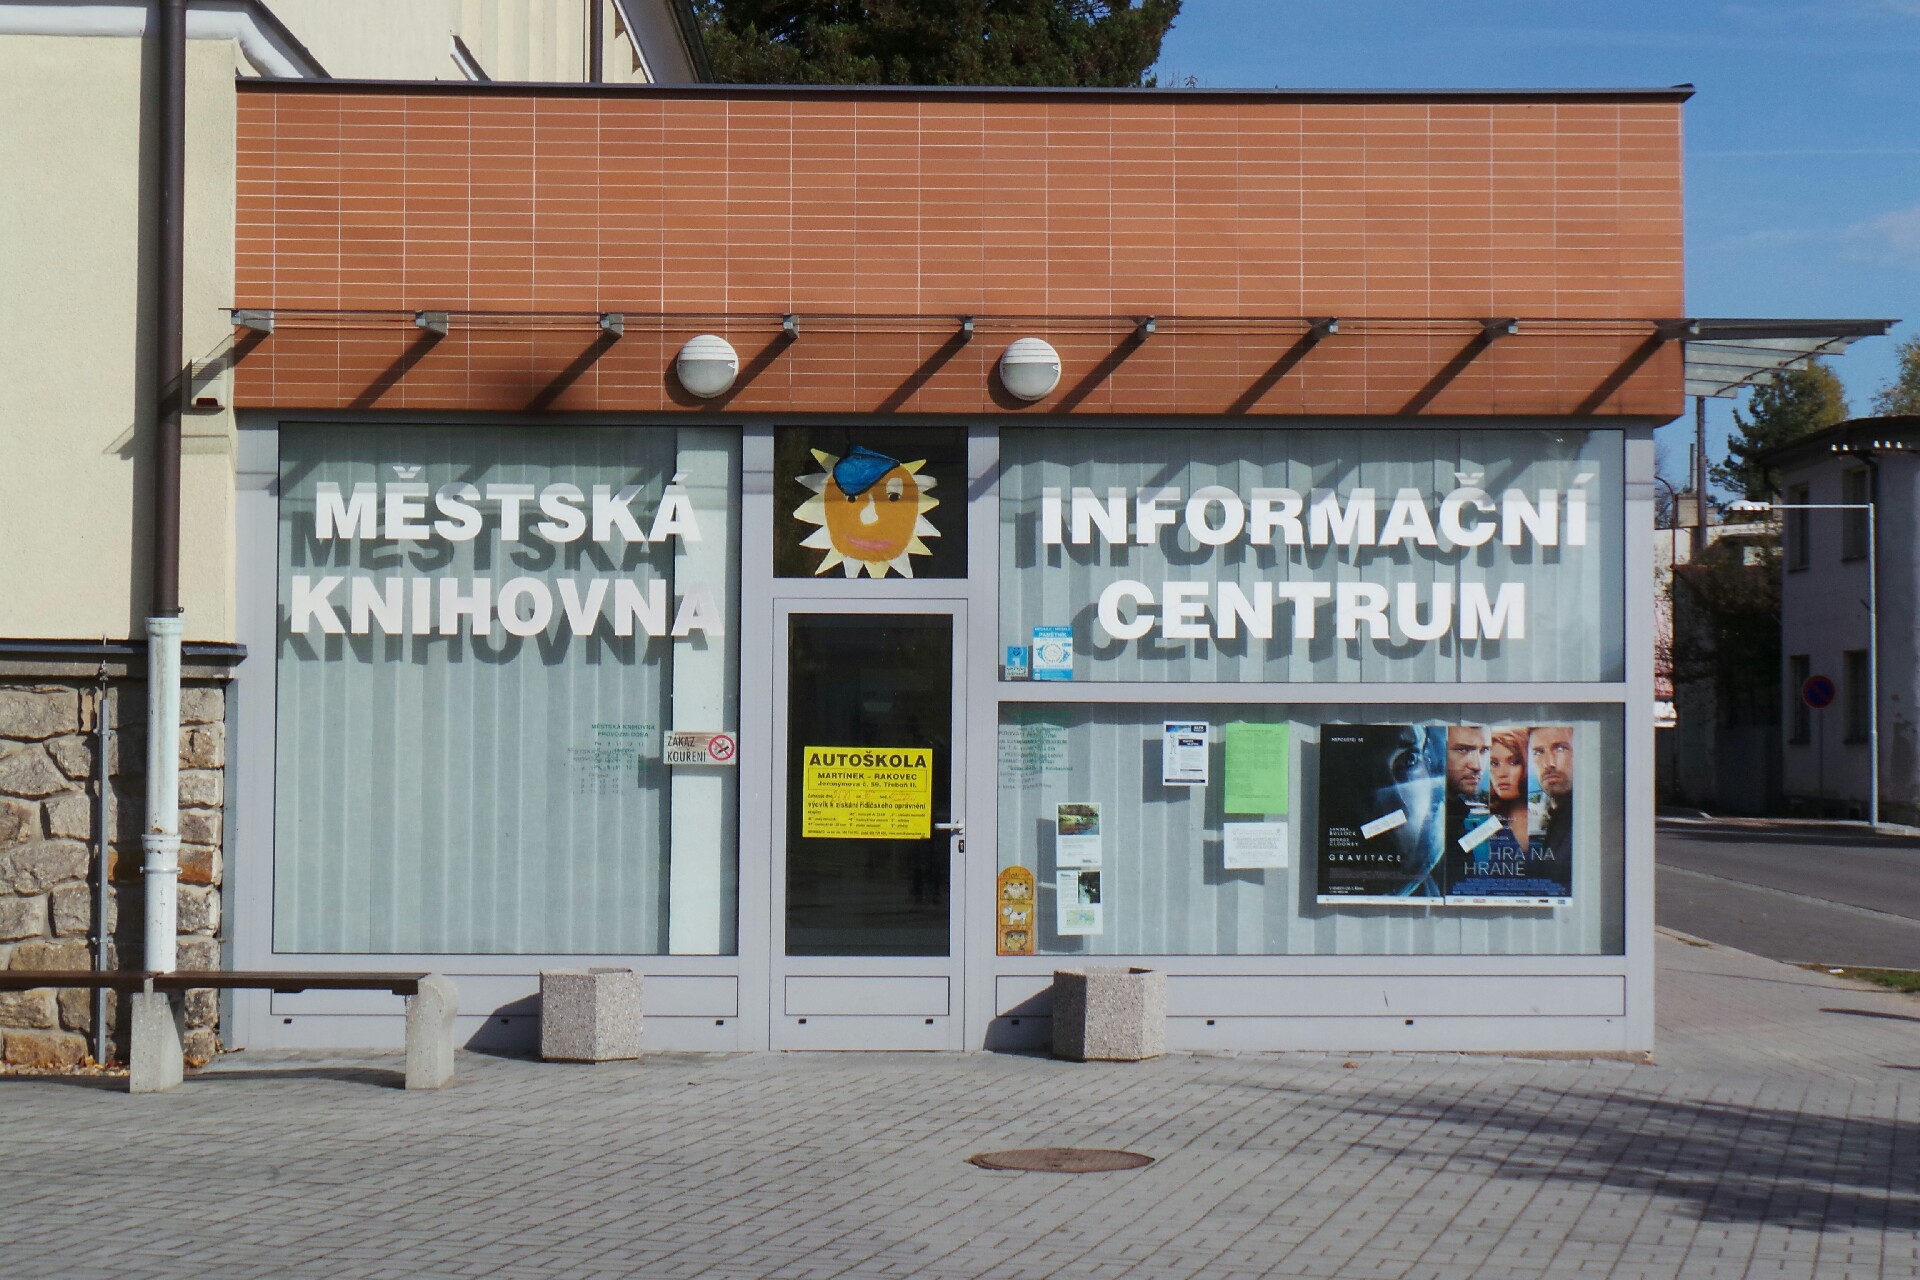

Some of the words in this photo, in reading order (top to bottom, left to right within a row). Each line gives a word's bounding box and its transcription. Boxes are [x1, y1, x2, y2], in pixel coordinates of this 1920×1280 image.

[315, 466, 703, 543] MĚSTSKÁ
[1042, 473, 1595, 547] INFORMAČNÍ
[290, 576, 725, 637] KNIHOVNA
[1097, 579, 1525, 640] CENTRUM
[667, 735, 696, 747] ZÁKAZ
[667, 748, 706, 763] KOUŘENÍ
[809, 750, 927, 769] AUTOŠKOLA
[874, 772, 918, 780] RAKOVEC
[884, 781, 908, 789] Třeboň
[807, 801, 829, 810] výcvik
[1328, 853, 1402, 862] GRAVITACE
[1488, 846, 1527, 861] HRA
[1531, 847, 1556, 861] NA
